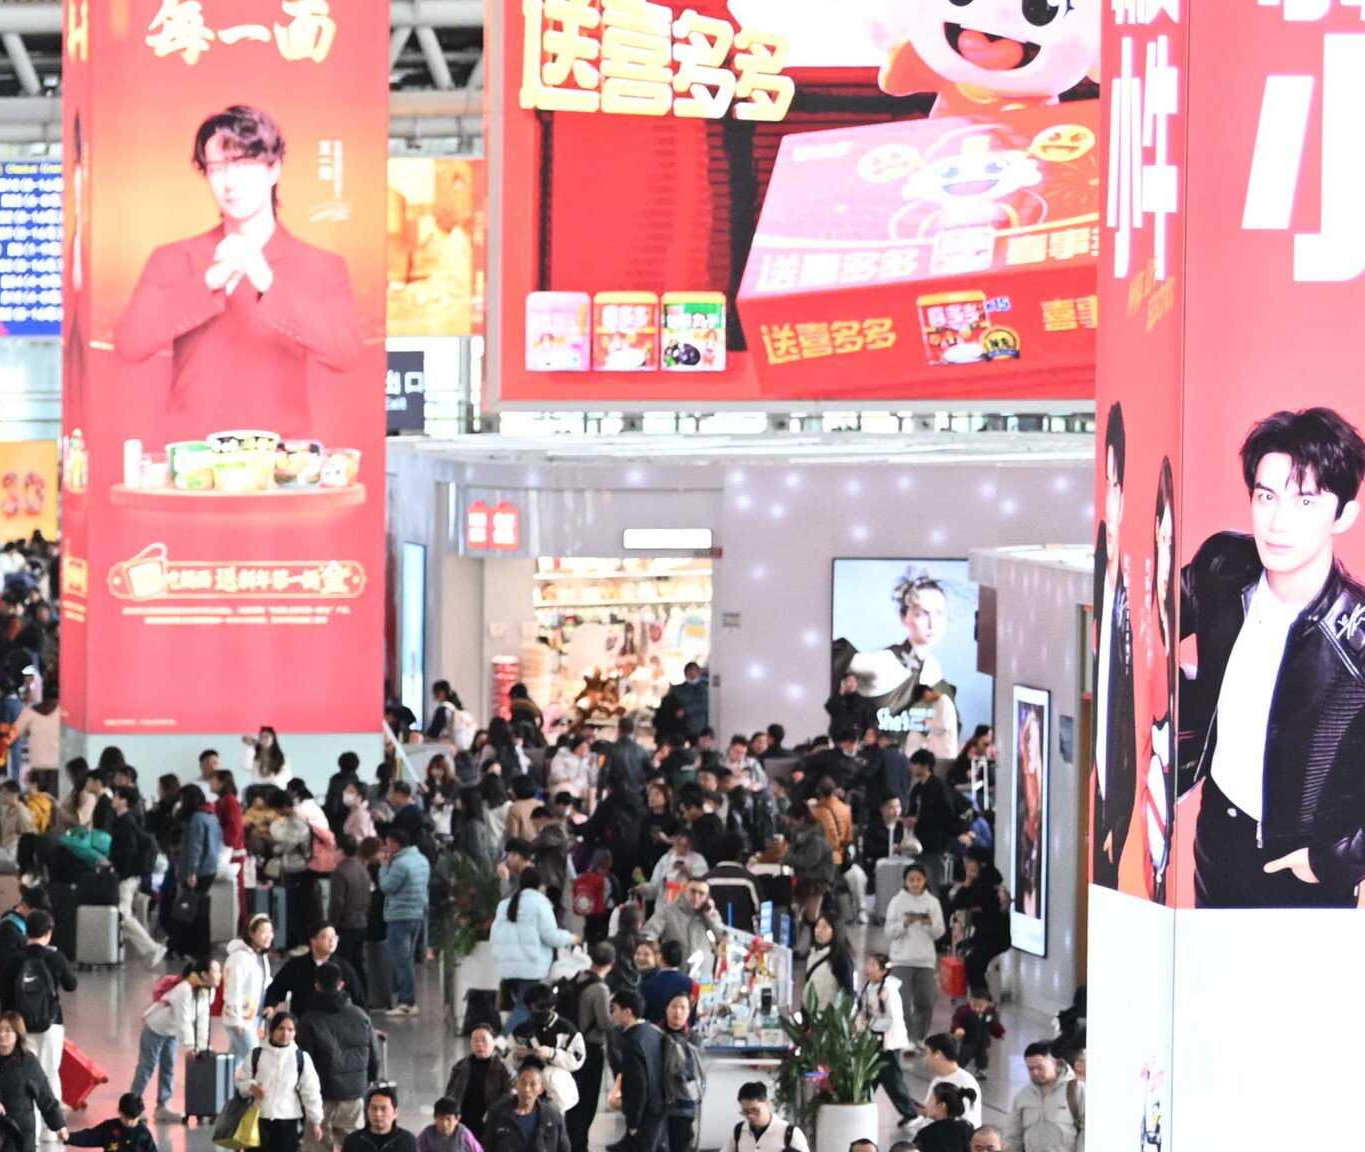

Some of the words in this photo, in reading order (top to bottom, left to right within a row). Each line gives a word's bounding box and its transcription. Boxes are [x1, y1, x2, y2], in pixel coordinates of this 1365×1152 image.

[519, 0, 795, 121] 送喜多多
[761, 317, 897, 364] 送喜多多
